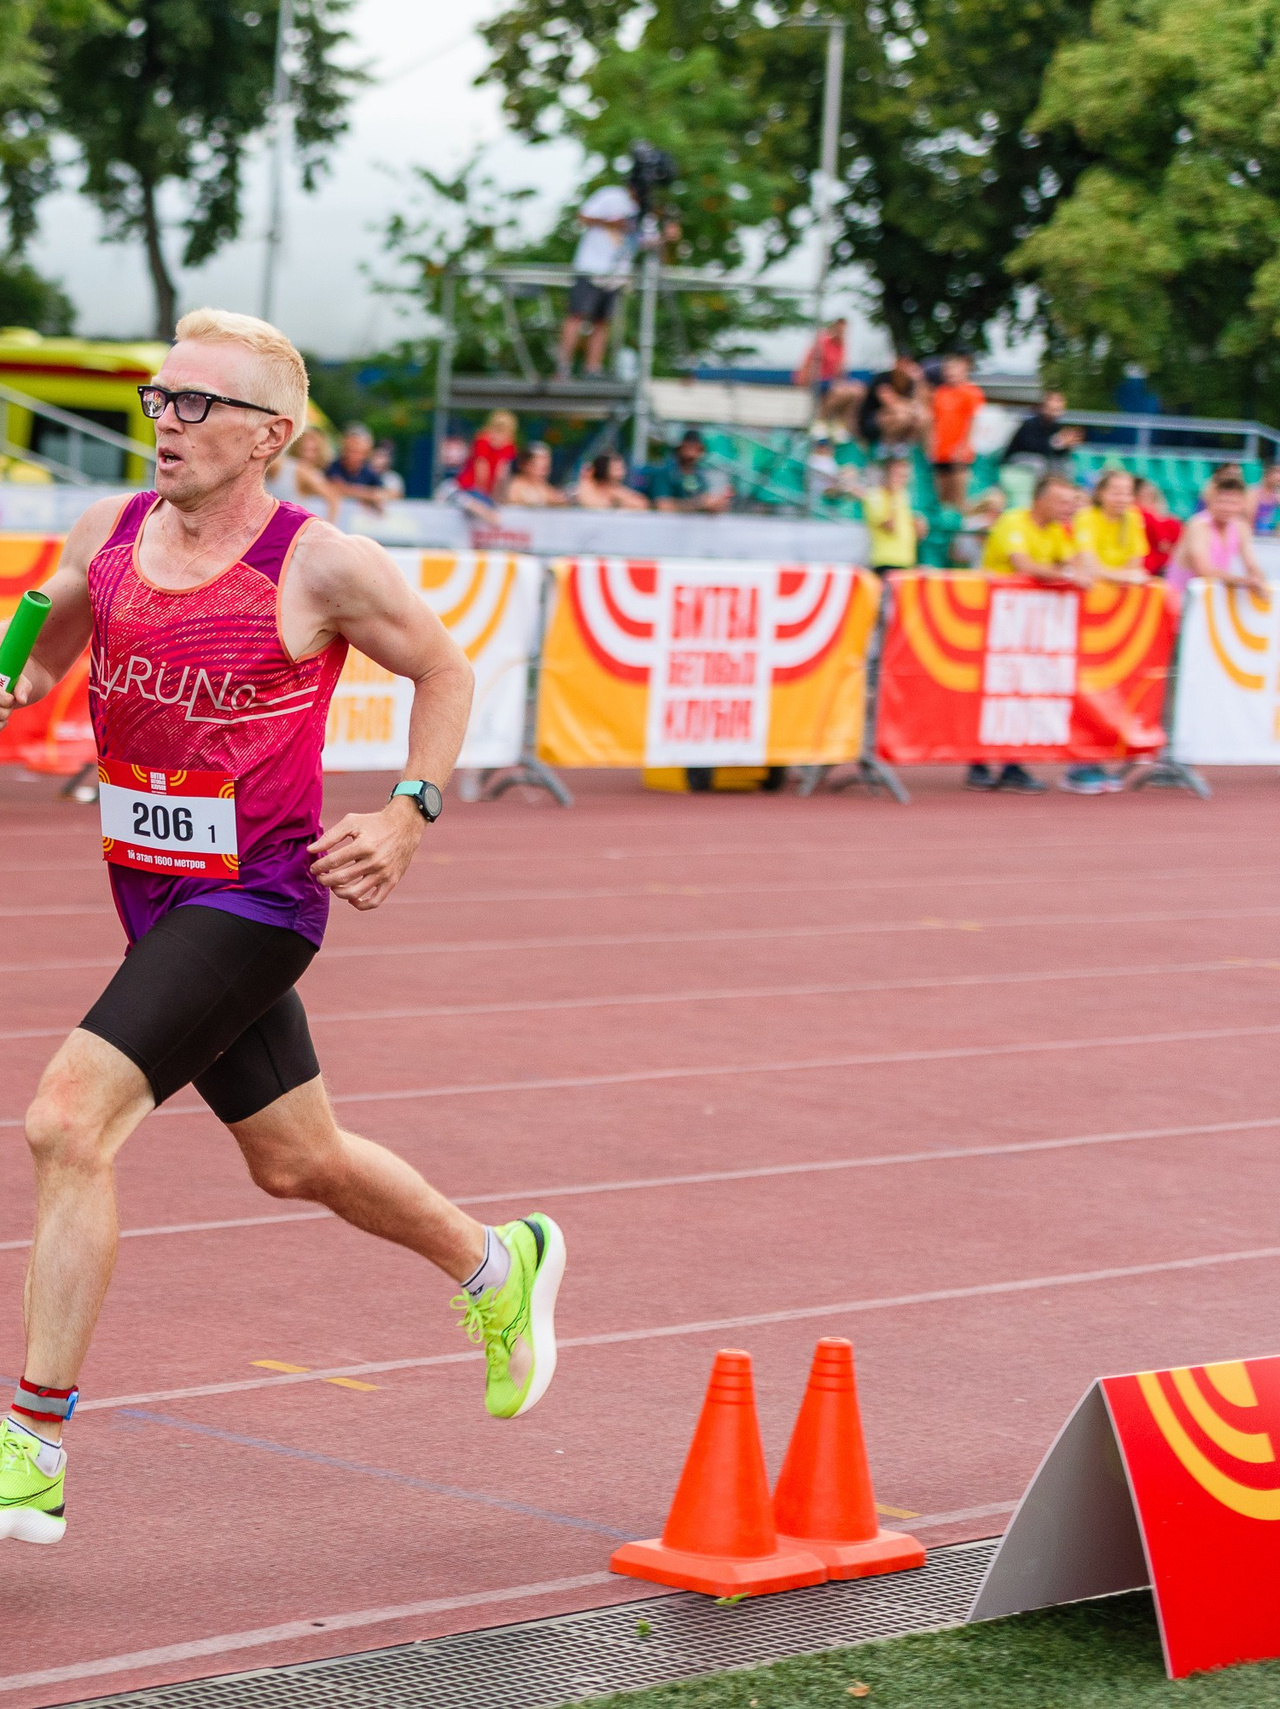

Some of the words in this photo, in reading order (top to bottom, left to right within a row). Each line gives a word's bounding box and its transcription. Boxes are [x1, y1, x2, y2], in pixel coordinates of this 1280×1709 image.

[673, 585, 757, 639] БИТВА
[132, 801, 194, 842] 206
[208, 825, 216, 844] 1
[127, 849, 135, 860] 1й
[136, 852, 153, 864] этап
[154, 855, 173, 867] 1600
[174, 858, 206, 870] метров
